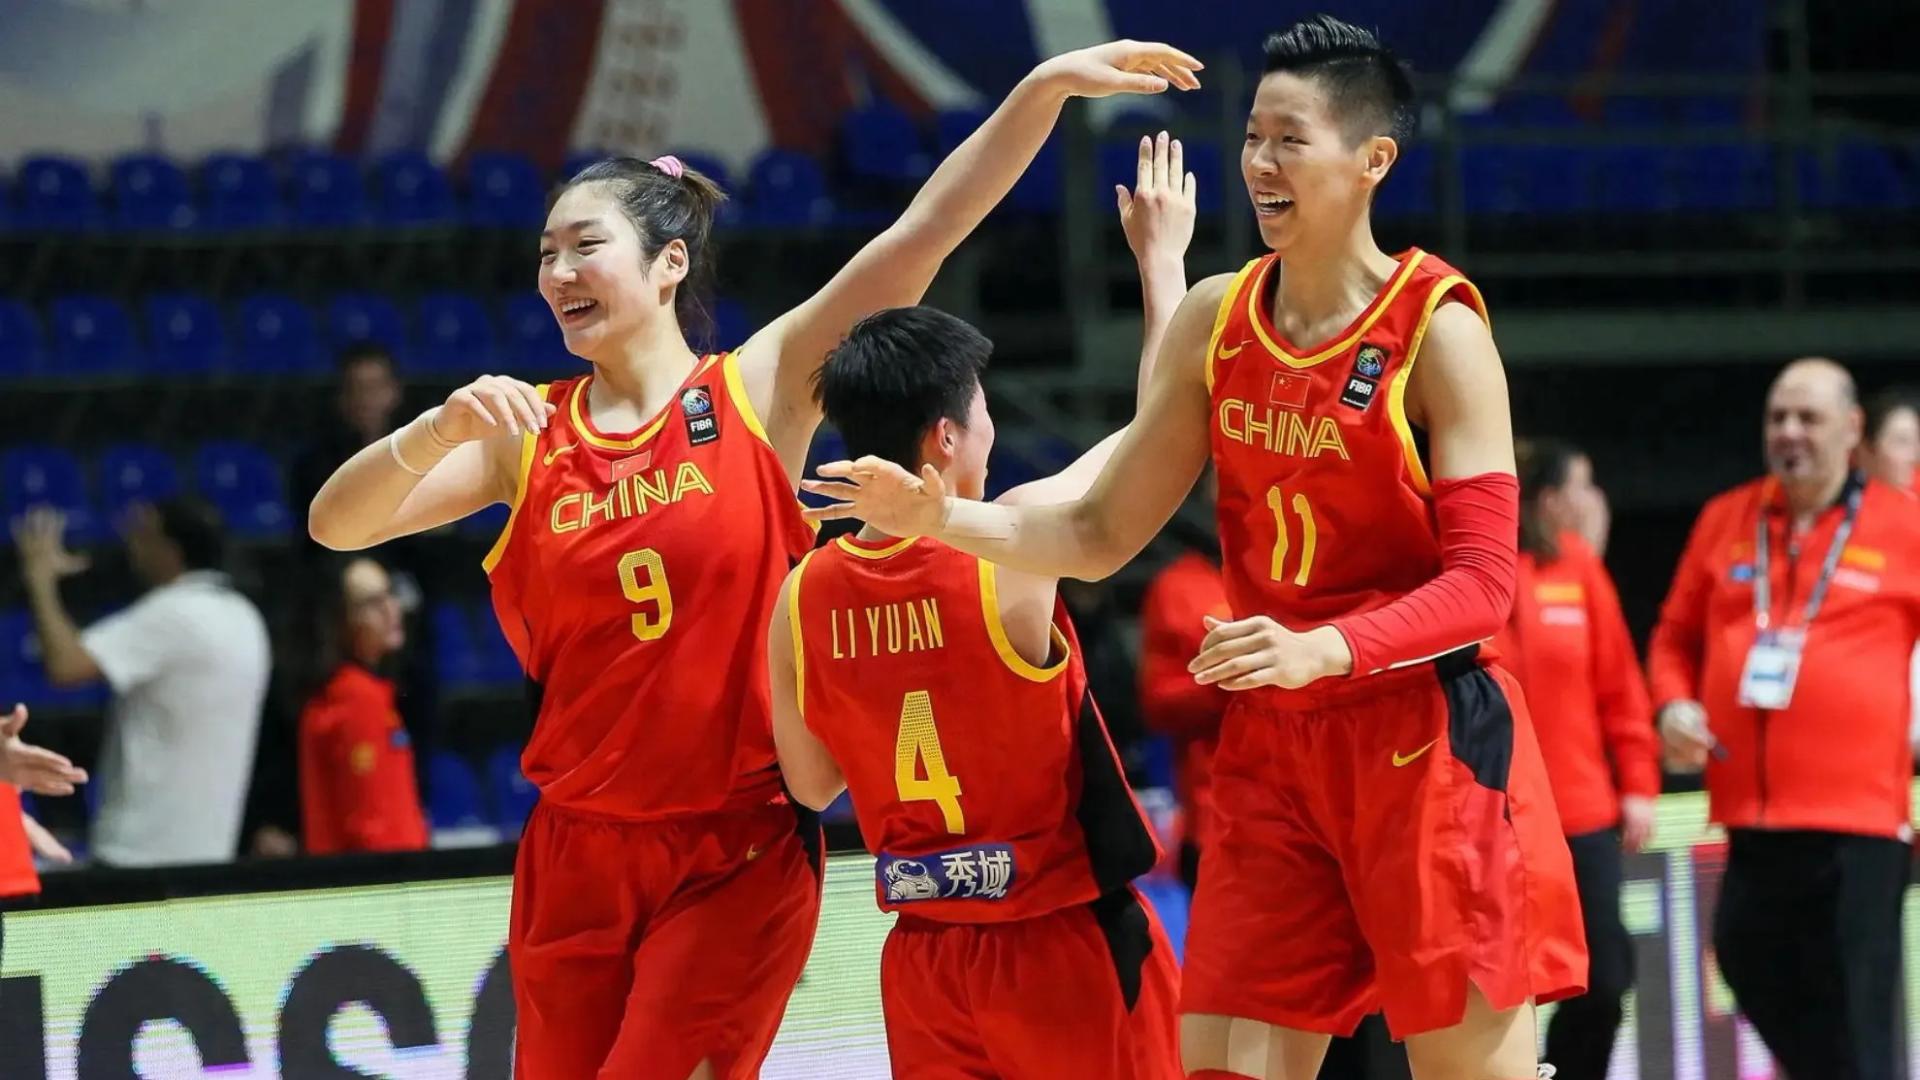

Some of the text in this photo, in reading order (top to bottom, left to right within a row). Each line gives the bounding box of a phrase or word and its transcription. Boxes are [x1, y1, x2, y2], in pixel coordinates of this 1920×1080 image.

[1349, 379, 1372, 396] FIBA
[690, 418, 713, 432] FIBA
[1219, 398, 1350, 460] CHINA
[551, 461, 715, 534] CHINA
[1267, 486, 1316, 587] 11
[617, 547, 673, 641] 9
[832, 597, 944, 659] LI YUAN
[895, 690, 965, 836] 4
[942, 850, 1012, 898] 秀域
